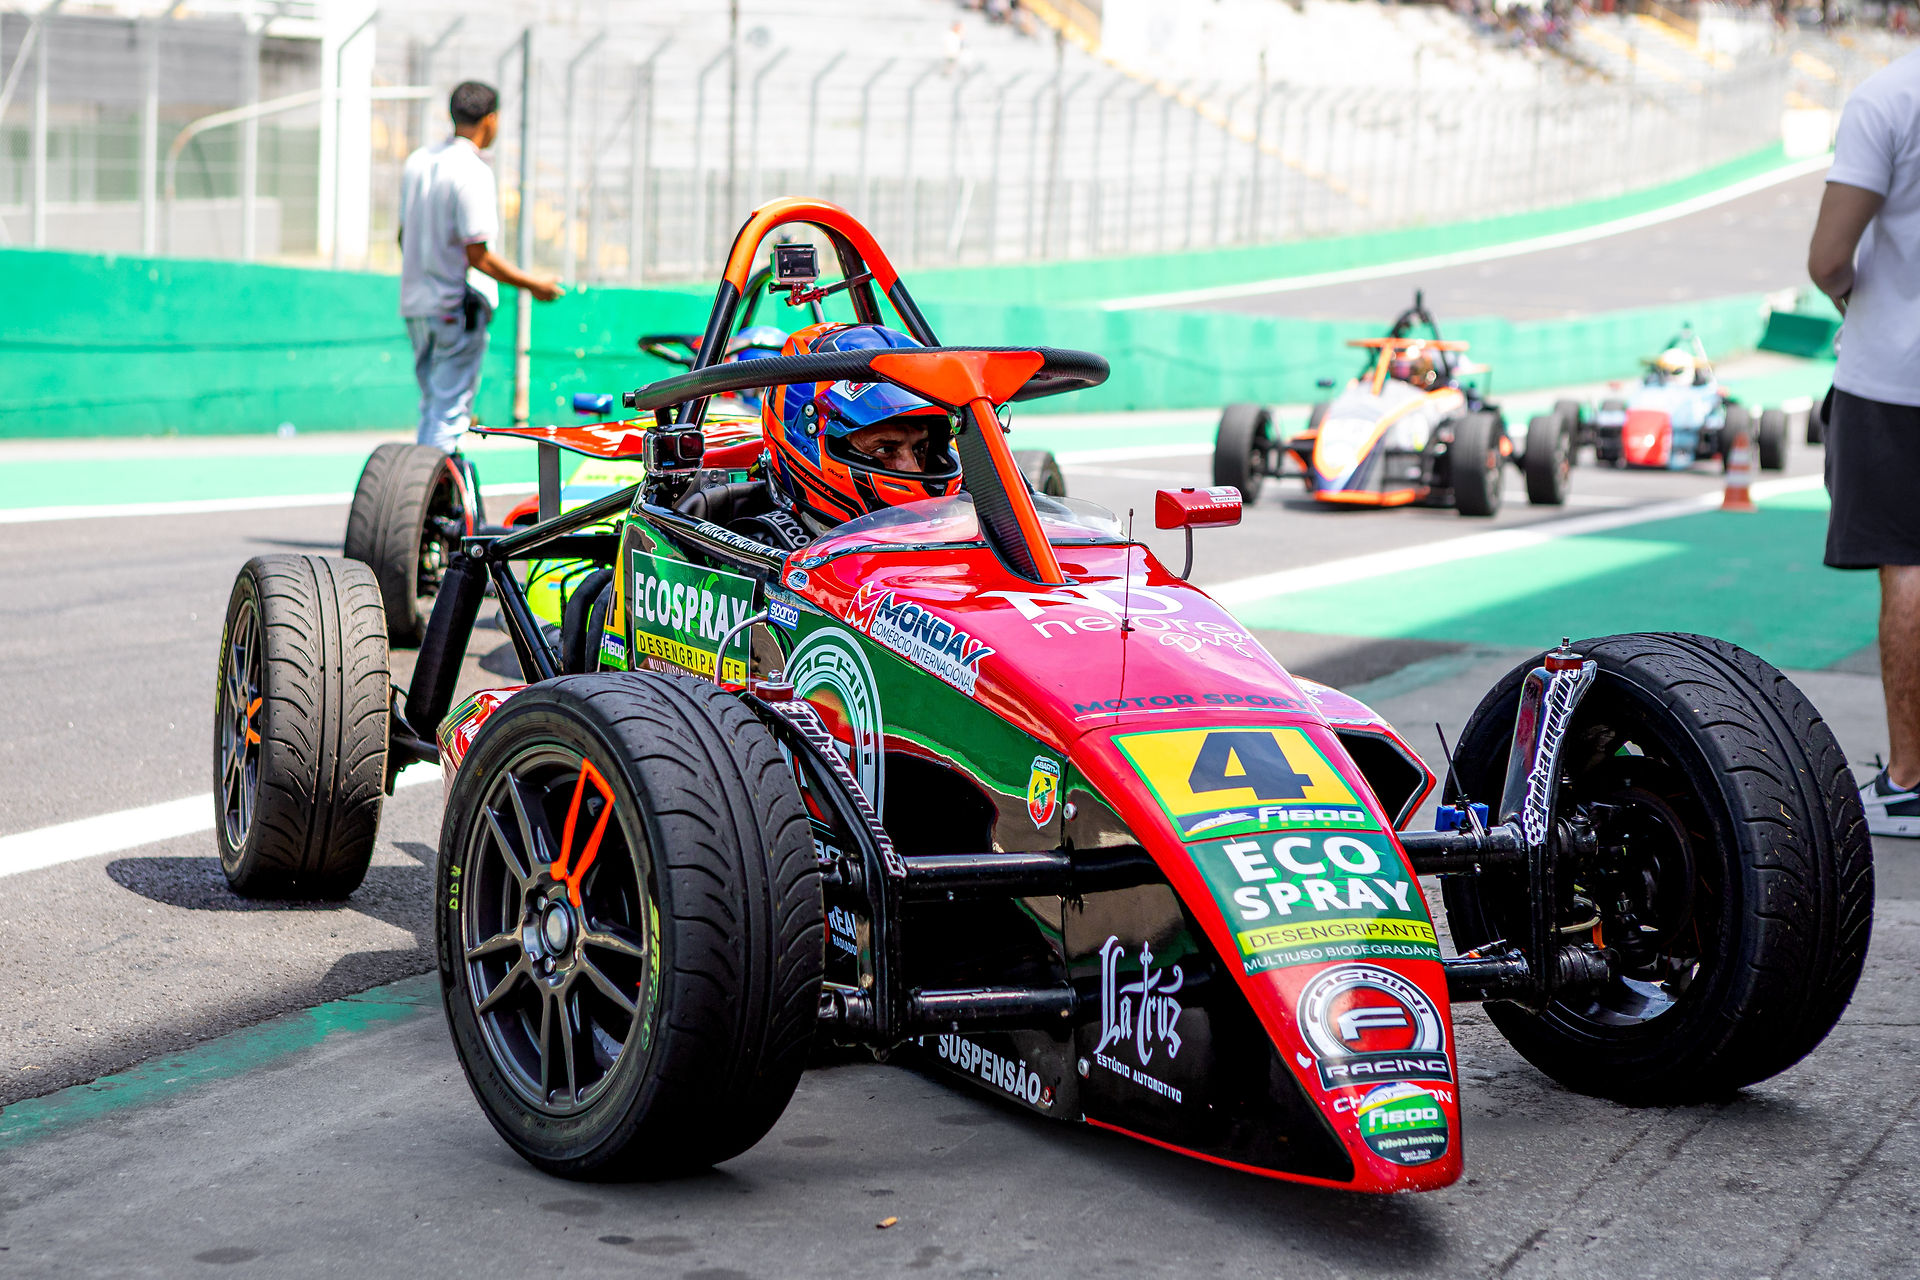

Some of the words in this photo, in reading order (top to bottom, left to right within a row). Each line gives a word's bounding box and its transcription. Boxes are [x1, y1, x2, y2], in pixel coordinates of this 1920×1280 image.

[635, 572, 748, 648] ECOSPRAY
[769, 602, 799, 624] sparco
[877, 592, 995, 669] MONDAY
[639, 634, 741, 684] DESENGRIPATE
[871, 620, 911, 652] COMÉRCIO
[911, 642, 976, 693] INTERNACIONAL
[1073, 693, 1200, 714] MOTOR
[1034, 760, 1058, 775] ABARTH
[1187, 731, 1314, 801] 4
[1222, 836, 1382, 882] ECO
[1233, 877, 1412, 922] SPRAY
[1243, 945, 1323, 973] MULTIUSO
[1326, 944, 1440, 959] BIODEGRADÁVE
[1249, 922, 1435, 949] DESENGRIPANTE
[938, 1033, 1041, 1105] SUSPENSÃO
[1096, 1053, 1130, 1079] ESTÚDIO
[1132, 1069, 1182, 1104] AUTOMOTIVO
